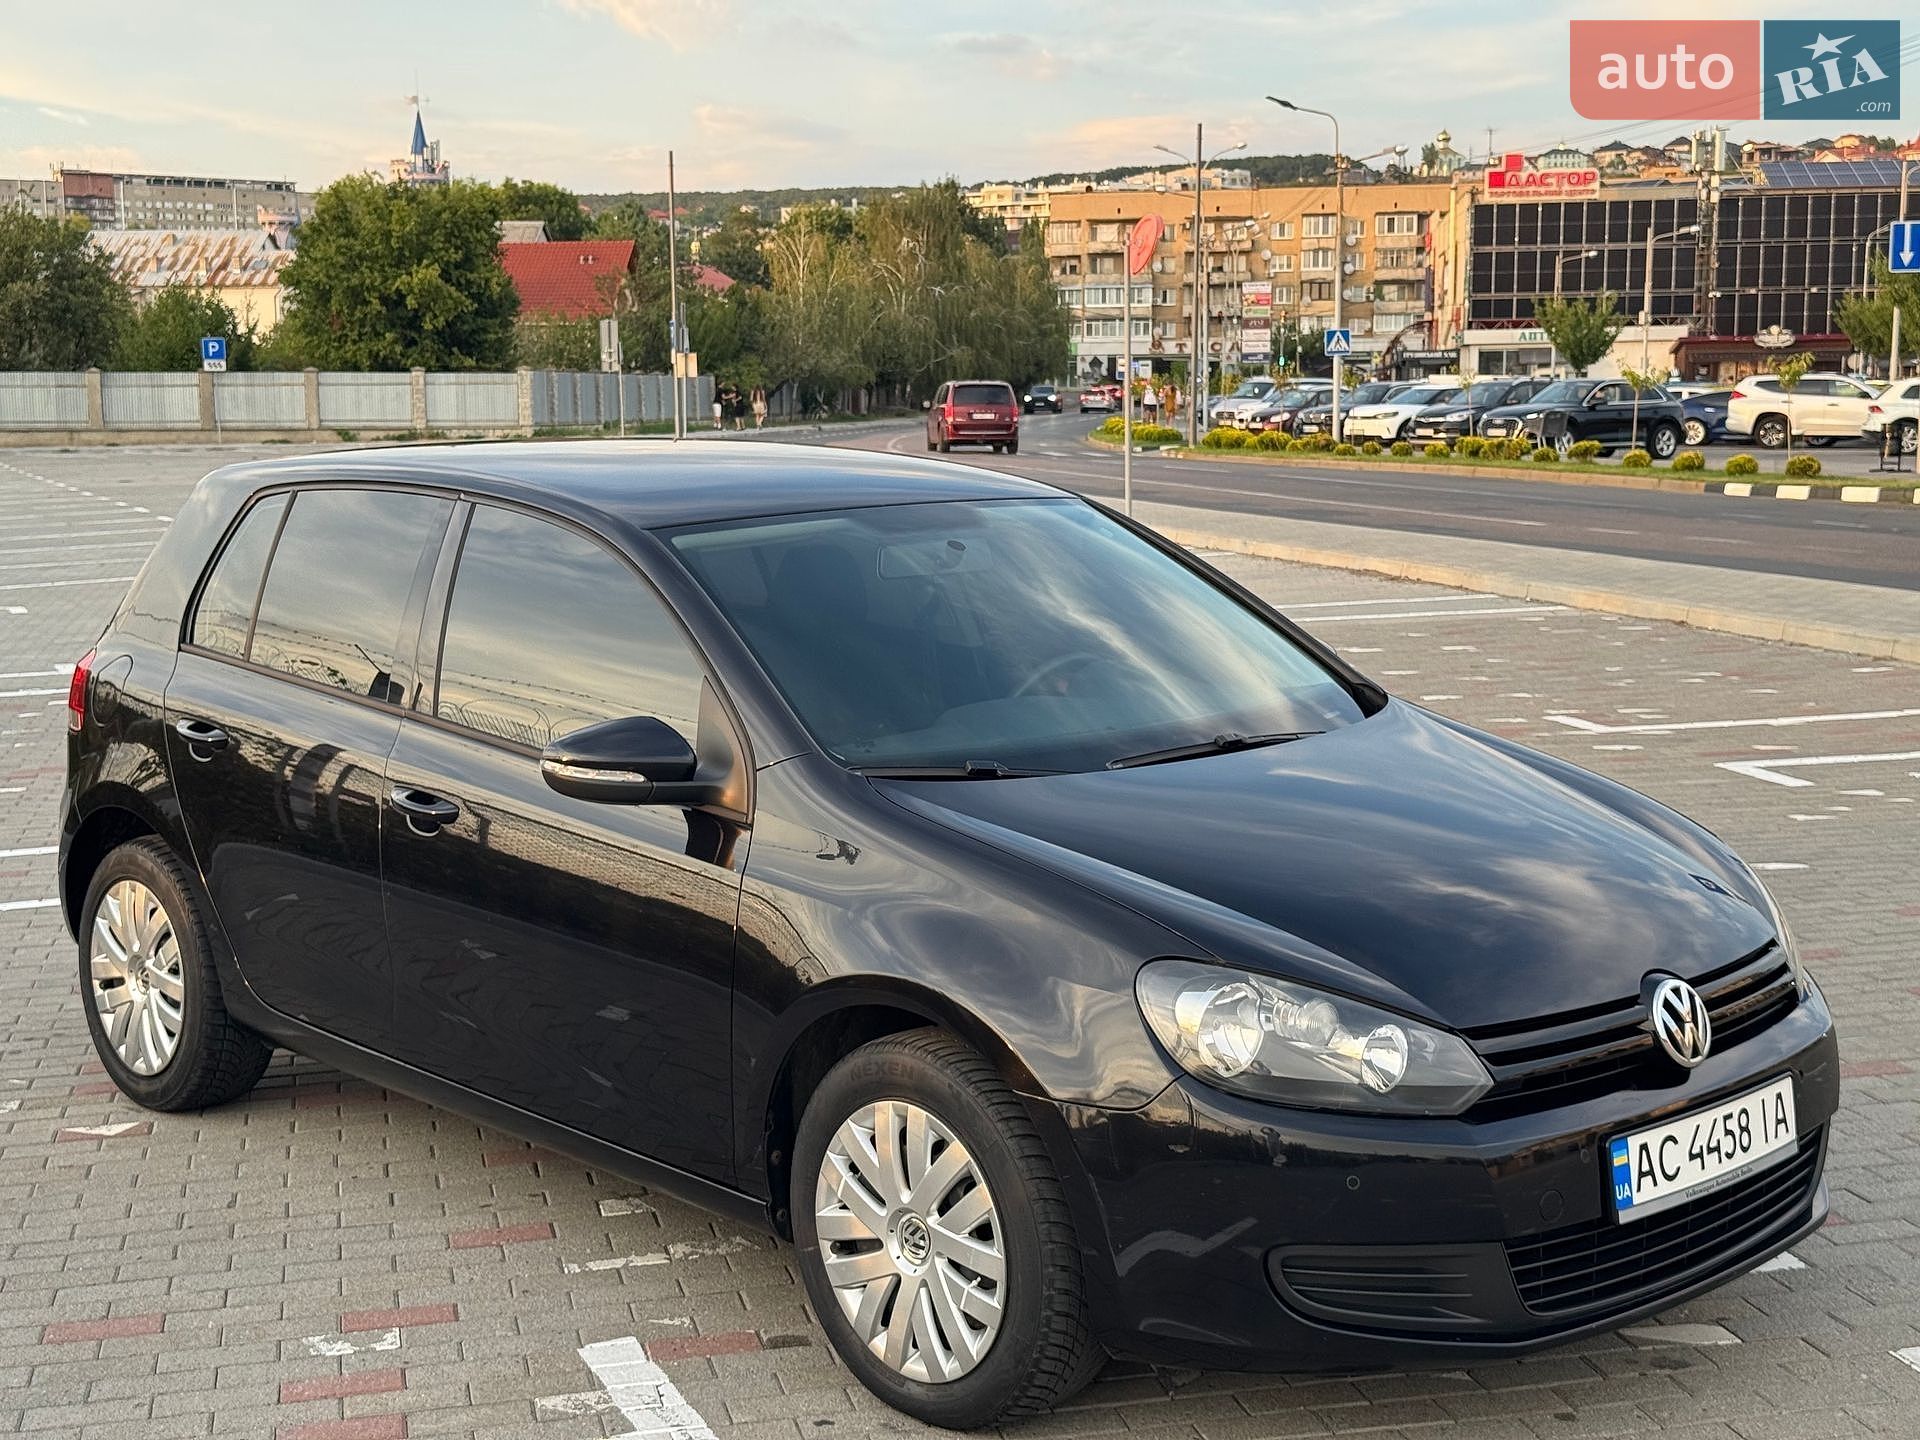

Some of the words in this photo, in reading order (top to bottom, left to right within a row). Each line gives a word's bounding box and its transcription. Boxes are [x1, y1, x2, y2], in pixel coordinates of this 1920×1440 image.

[208, 341, 220, 357] P
[1636, 1134, 1682, 1193] AC
[1688, 1107, 1752, 1171] 4458
[1760, 1091, 1790, 1144] IA
[1615, 1182, 1632, 1200] UA
